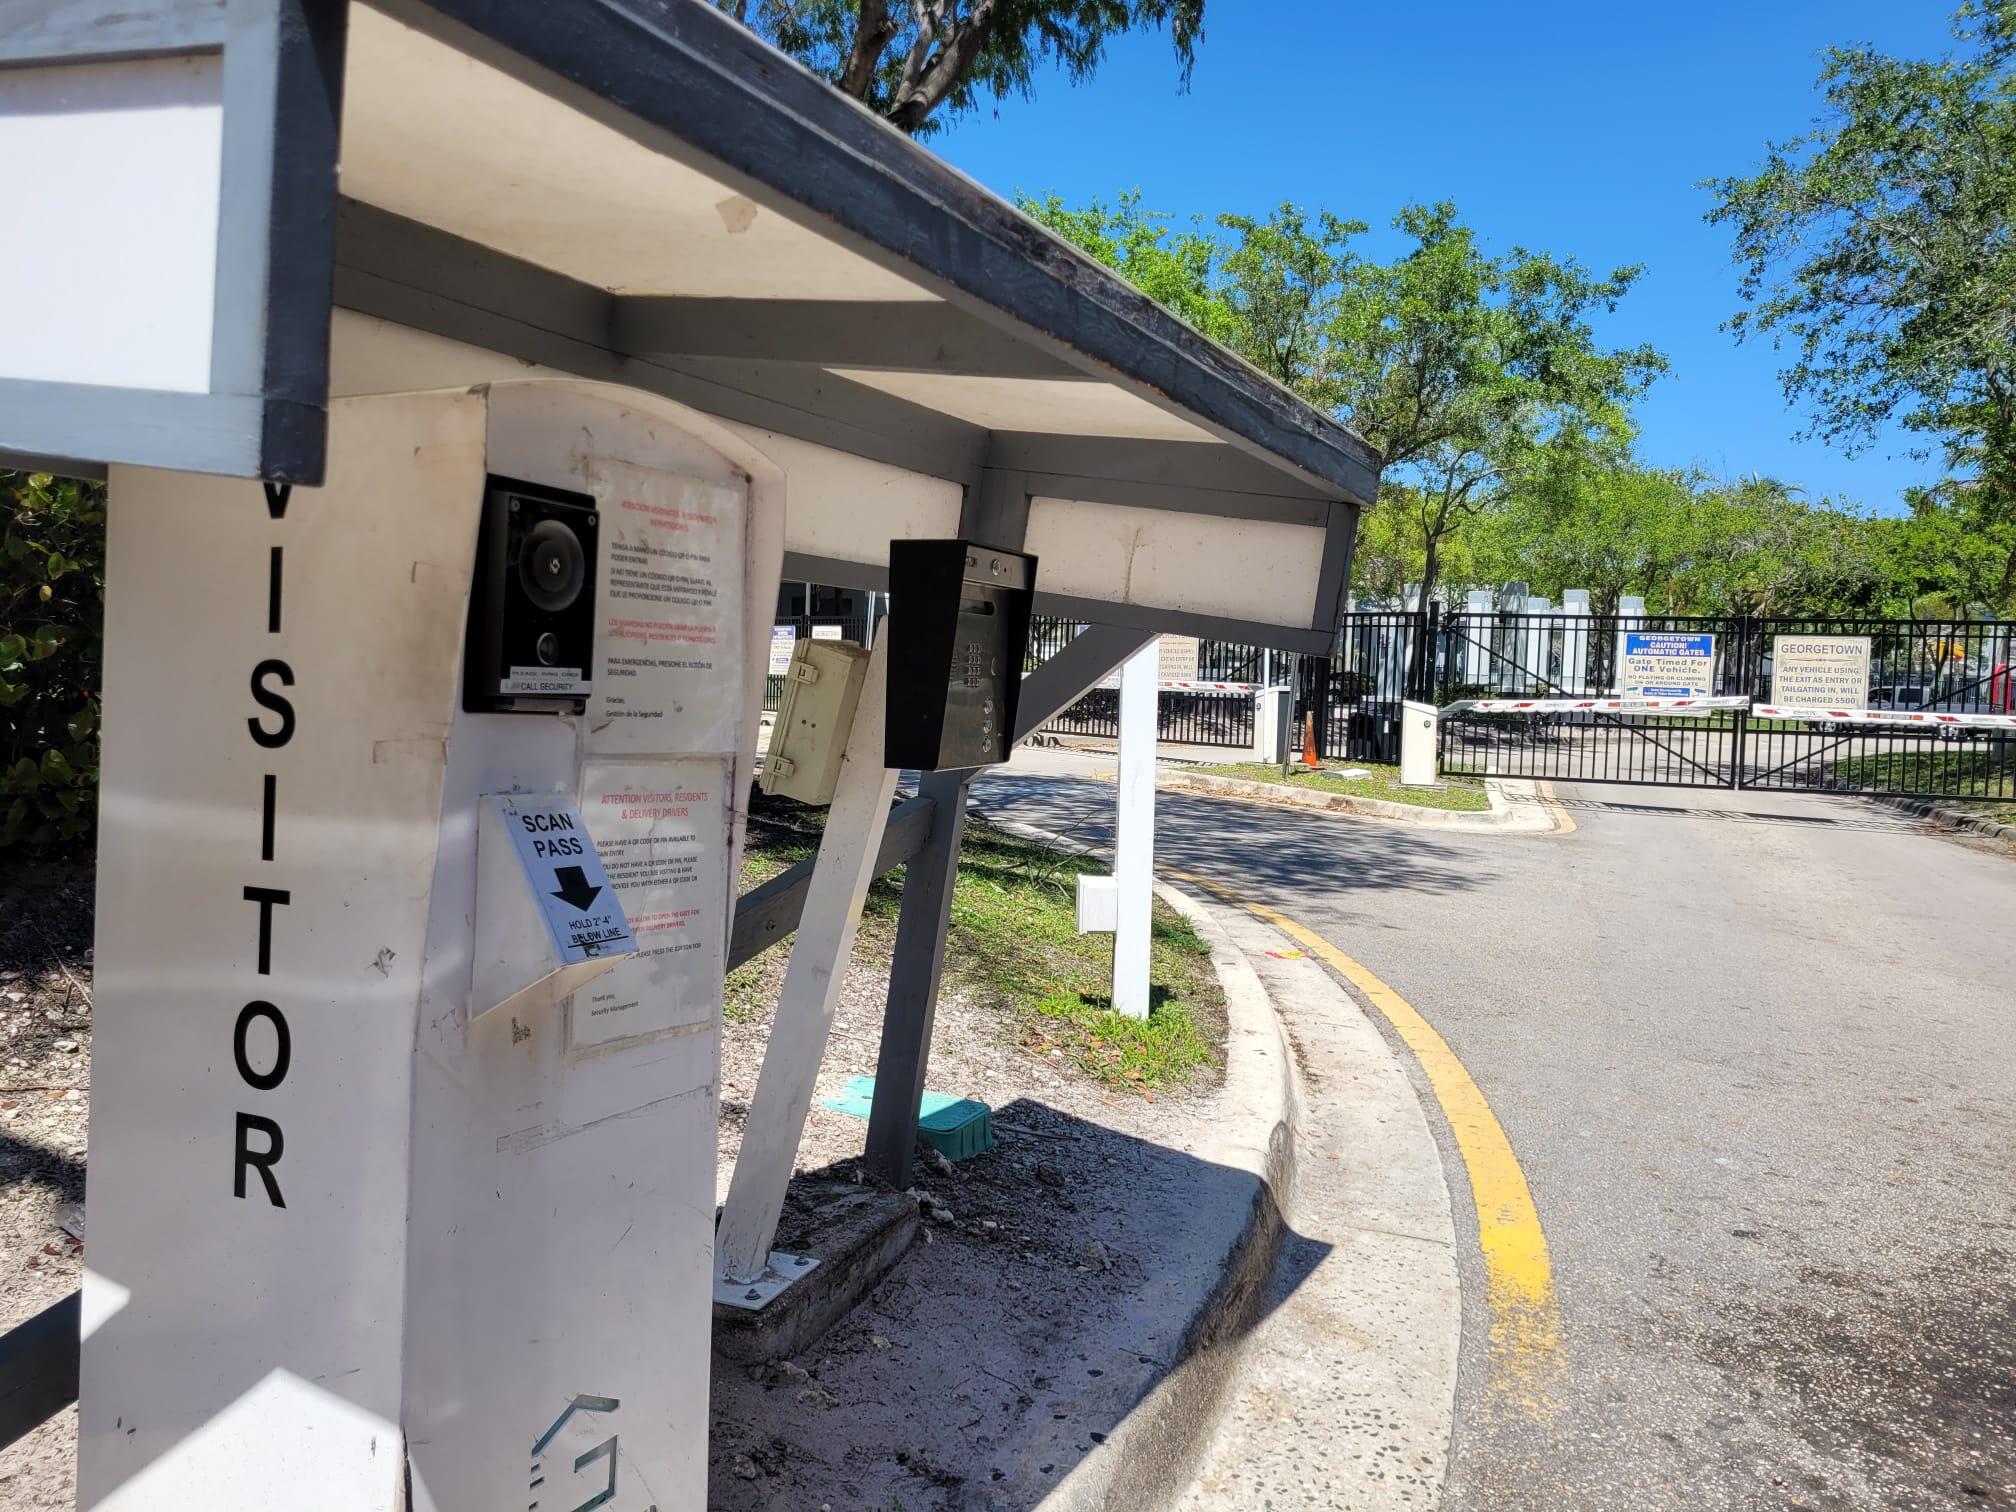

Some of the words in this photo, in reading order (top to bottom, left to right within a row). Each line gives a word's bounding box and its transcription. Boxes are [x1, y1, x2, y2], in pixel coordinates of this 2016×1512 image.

[1781, 644, 1862, 654] GEORGETOWN
[521, 682, 537, 690] CALL
[540, 682, 572, 691] SECURITY
[602, 794, 640, 804] ATTENTION
[621, 810, 627, 819] &
[630, 808, 660, 818] DELIVERY
[662, 807, 688, 817] DRIVERS
[522, 813, 574, 832] SCAN
[533, 838, 584, 858] PASS
[569, 918, 592, 931] HOLD
[572, 931, 602, 943] BELOW
[604, 928, 622, 939] LINE
